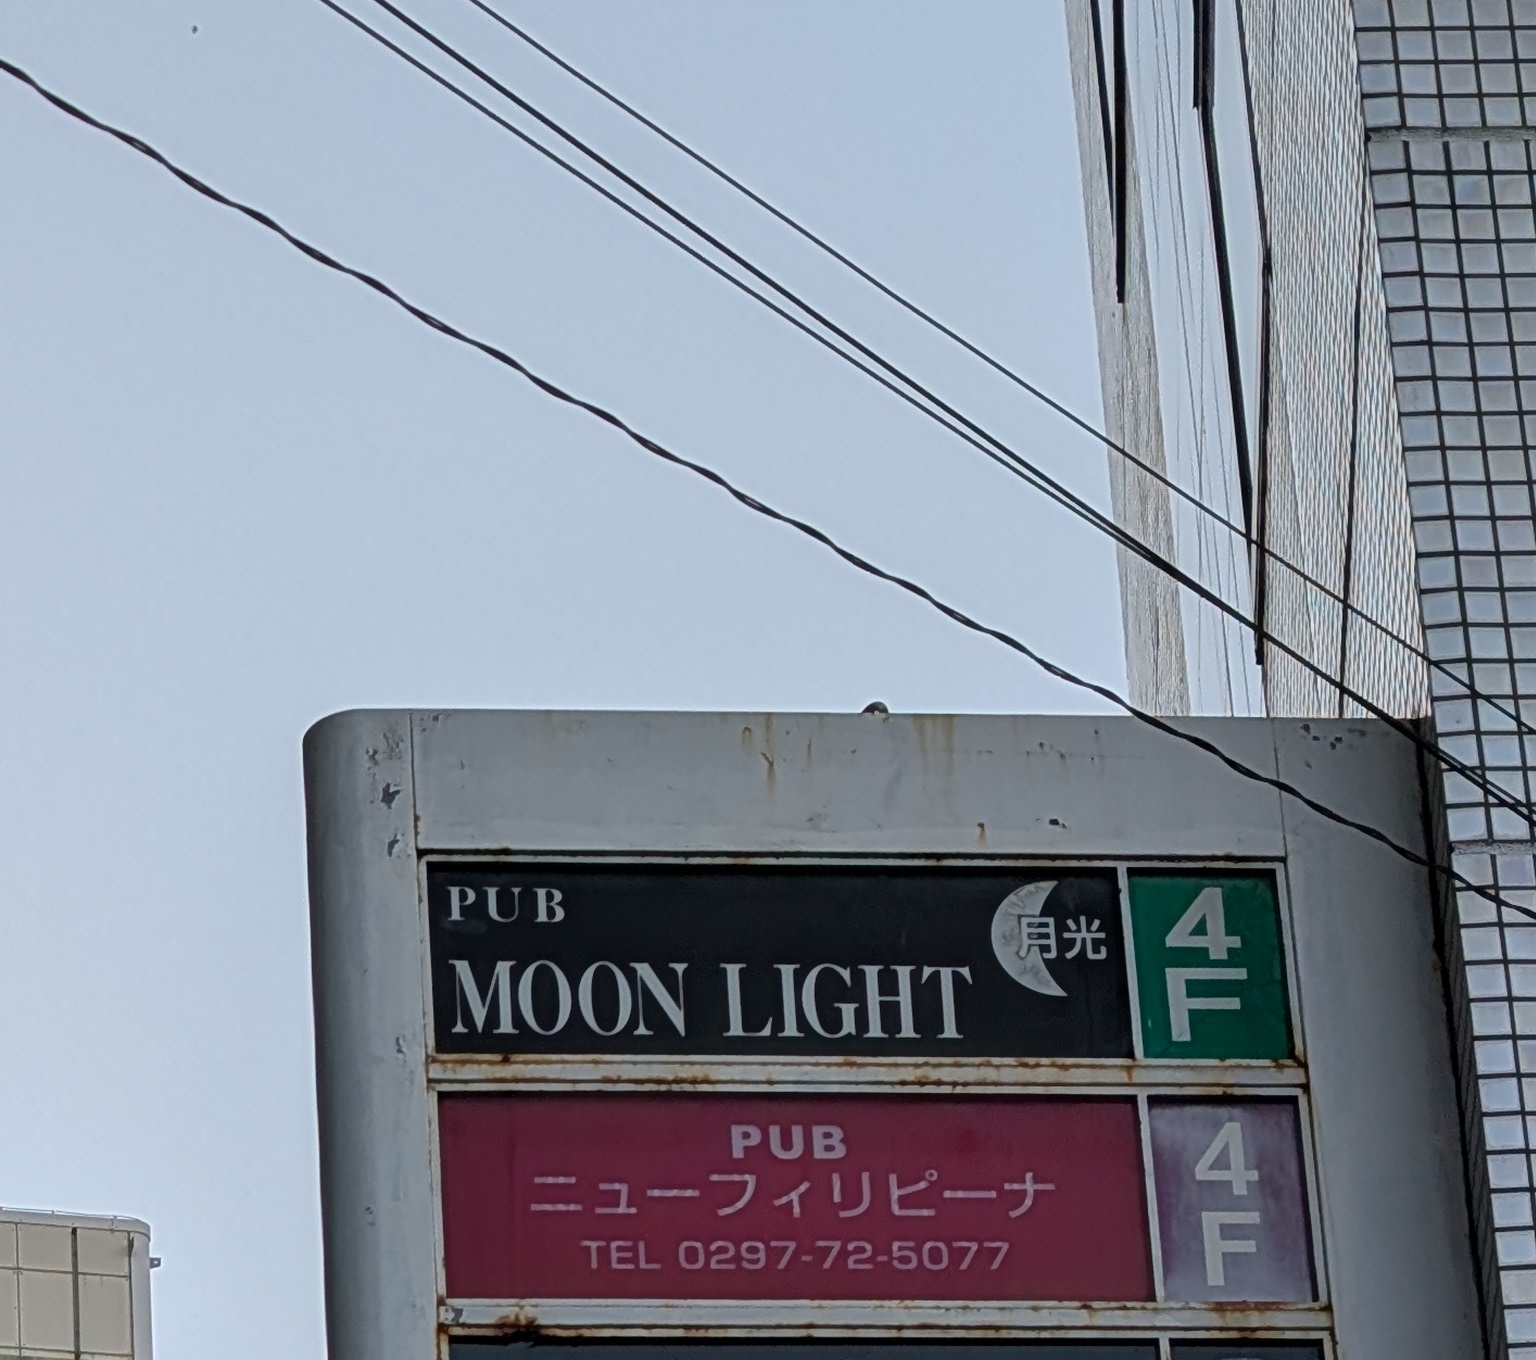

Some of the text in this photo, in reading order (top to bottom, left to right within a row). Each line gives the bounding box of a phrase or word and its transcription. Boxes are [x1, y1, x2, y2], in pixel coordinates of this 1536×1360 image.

[447, 886, 566, 923] PUB
[1017, 915, 1109, 961] 月光
[1164, 886, 1249, 1043] 4F
[449, 959, 973, 1041] MOON LIGHT
[730, 1125, 847, 1161] PUB
[530, 1171, 1057, 1219] ニューフィリピーナ
[1194, 1122, 1261, 1287] 4F
[581, 1240, 1011, 1272] TEL 0297-72-5077
